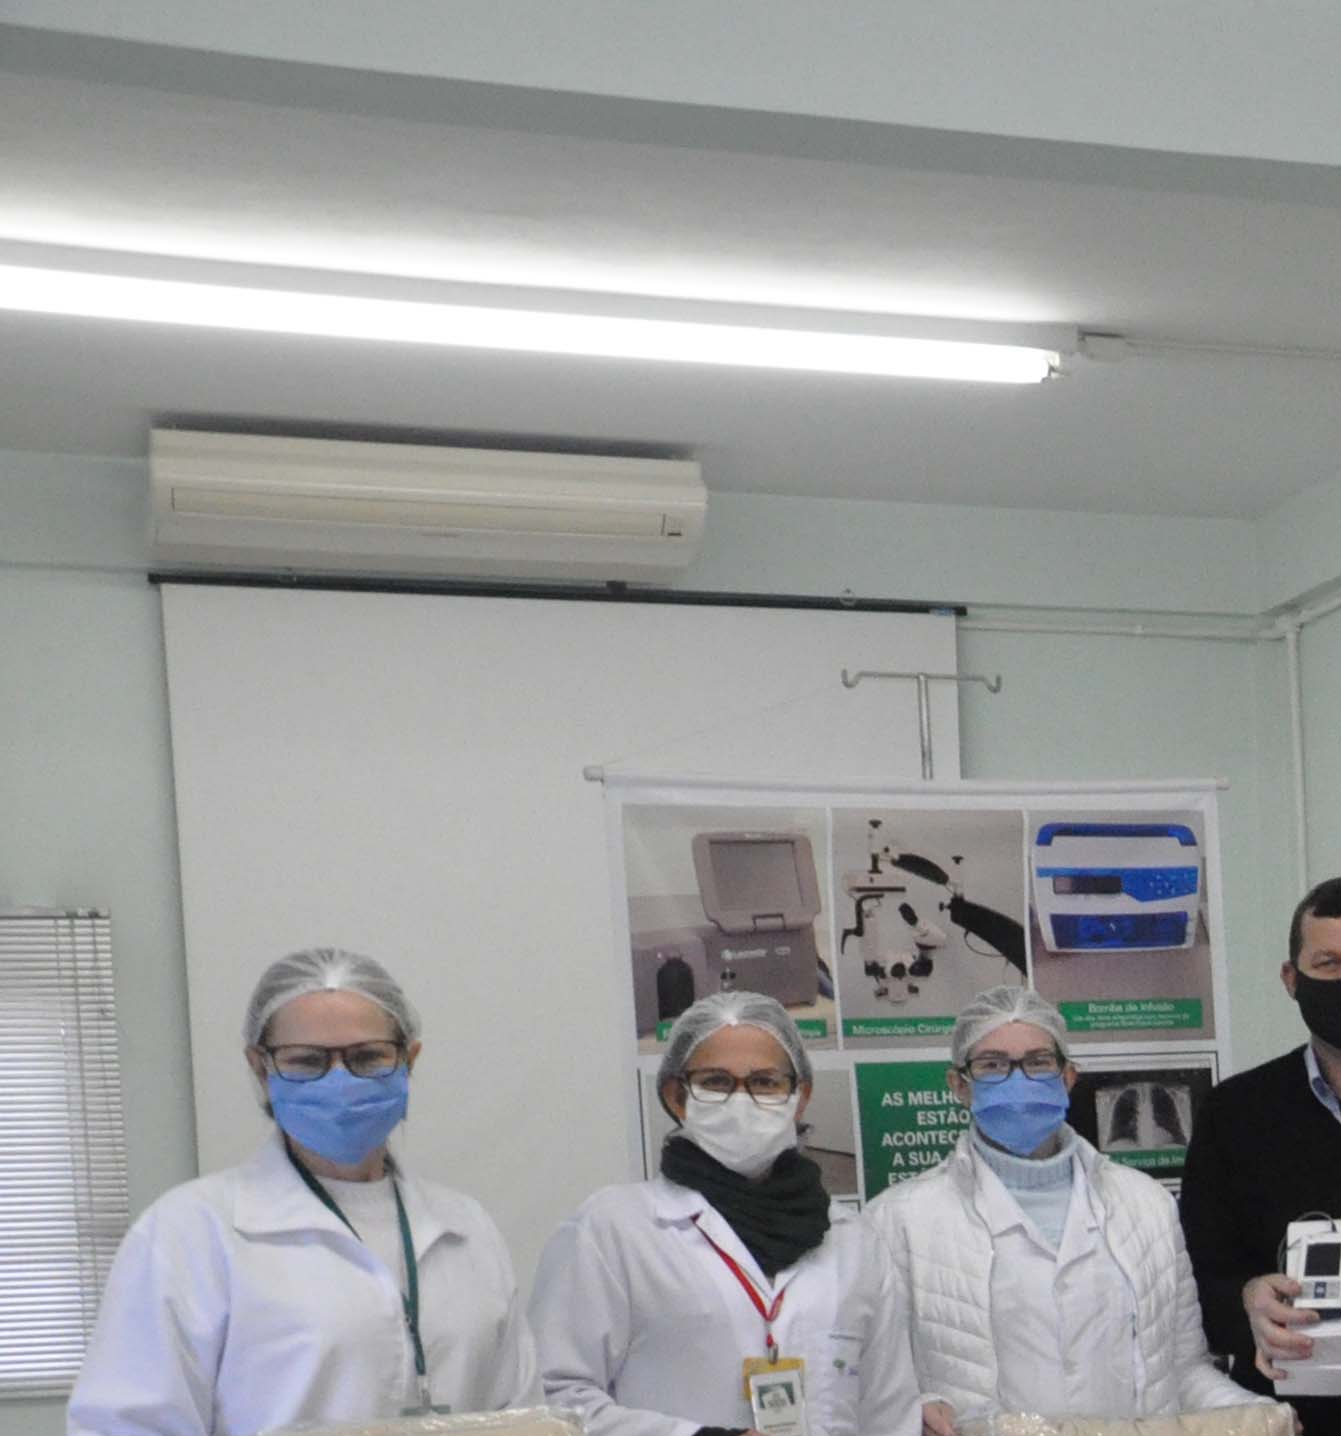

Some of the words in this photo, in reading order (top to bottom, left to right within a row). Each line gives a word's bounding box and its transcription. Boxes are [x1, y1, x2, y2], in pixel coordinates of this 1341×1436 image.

[881, 1092, 904, 1107] AS
[916, 1107, 970, 1126] ESTÃO
[892, 1152, 905, 1168] A
[908, 1150, 941, 1167] SUA
